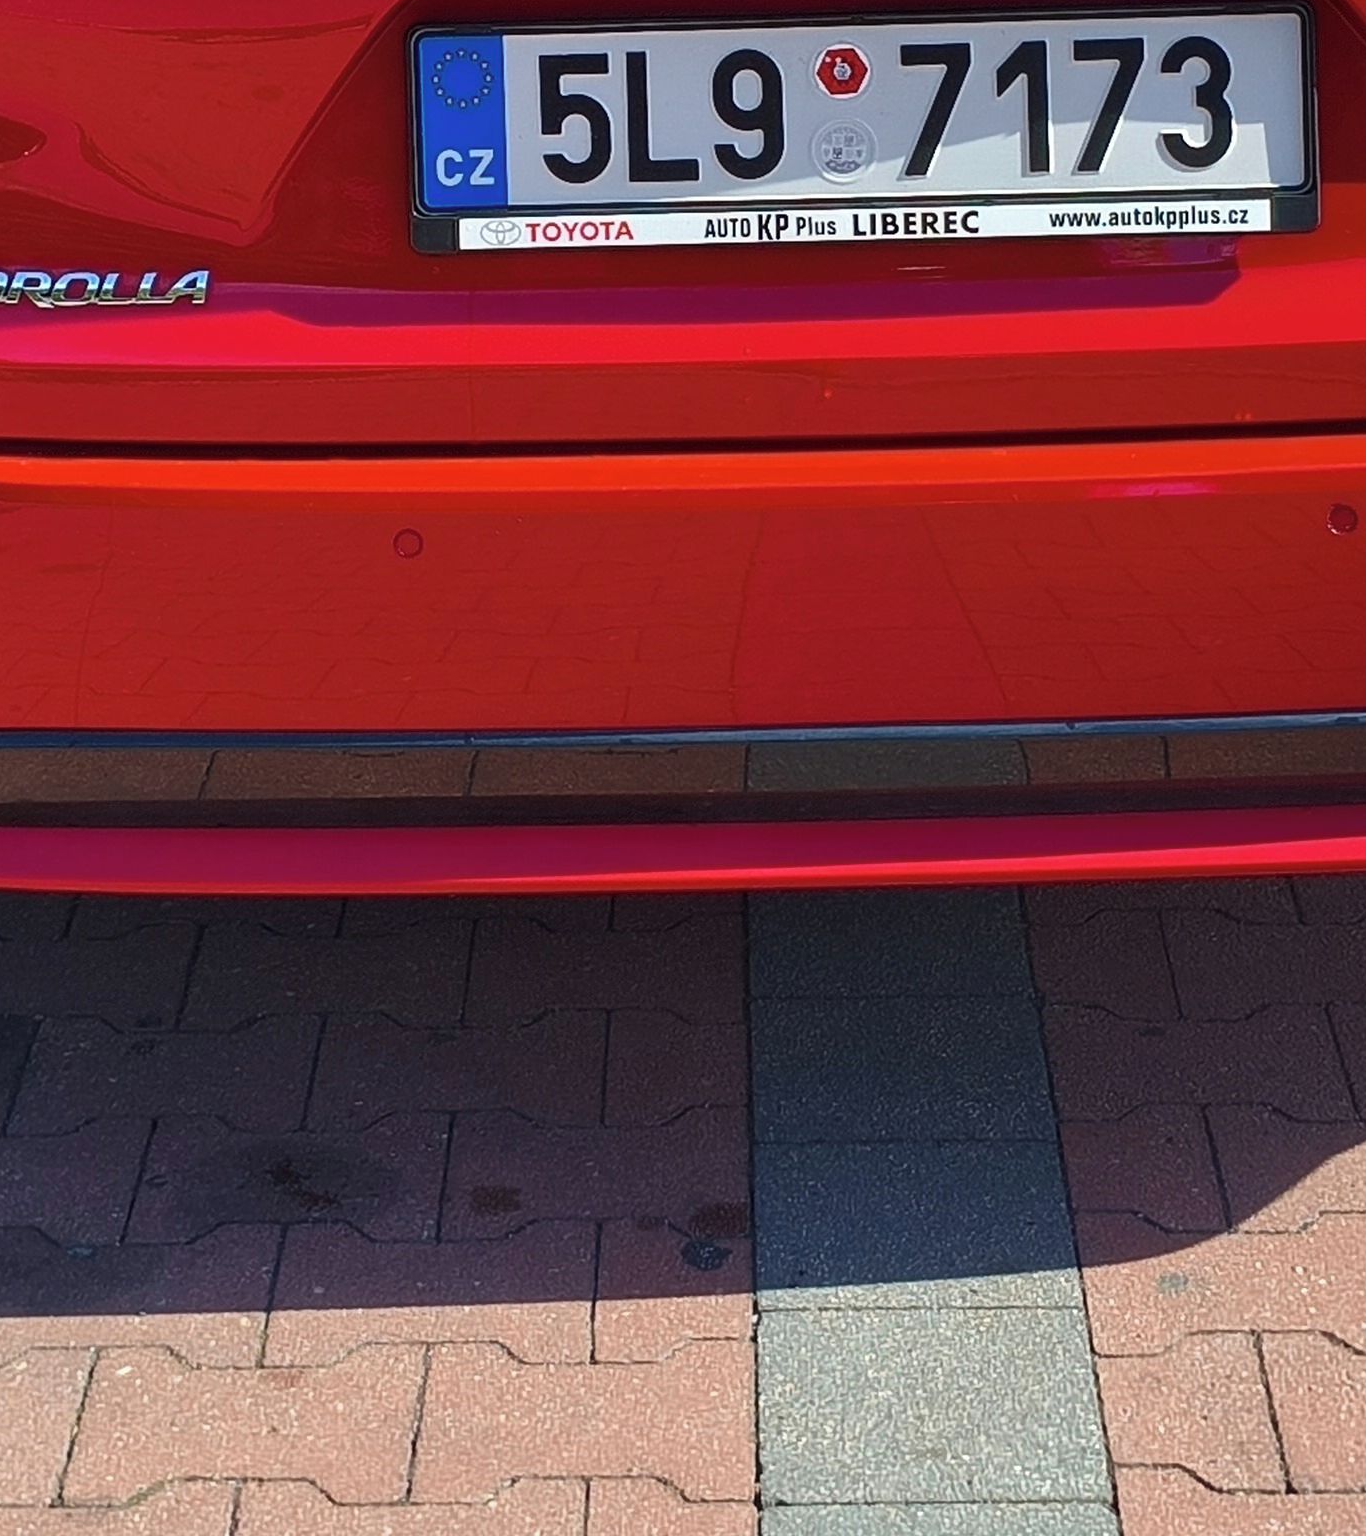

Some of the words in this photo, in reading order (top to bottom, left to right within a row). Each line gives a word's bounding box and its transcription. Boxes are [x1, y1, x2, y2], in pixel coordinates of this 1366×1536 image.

[538, 48, 785, 184] 5L9
[899, 36, 1233, 176] 7173
[435, 148, 496, 187] CZ
[524, 221, 634, 243] TOYOTA
[703, 217, 751, 239] AUTO
[756, 213, 789, 241] KP
[796, 216, 837, 237] Plus
[852, 210, 980, 237] LIBEREC
[1048, 205, 1249, 230] www.autokpplus.cz
